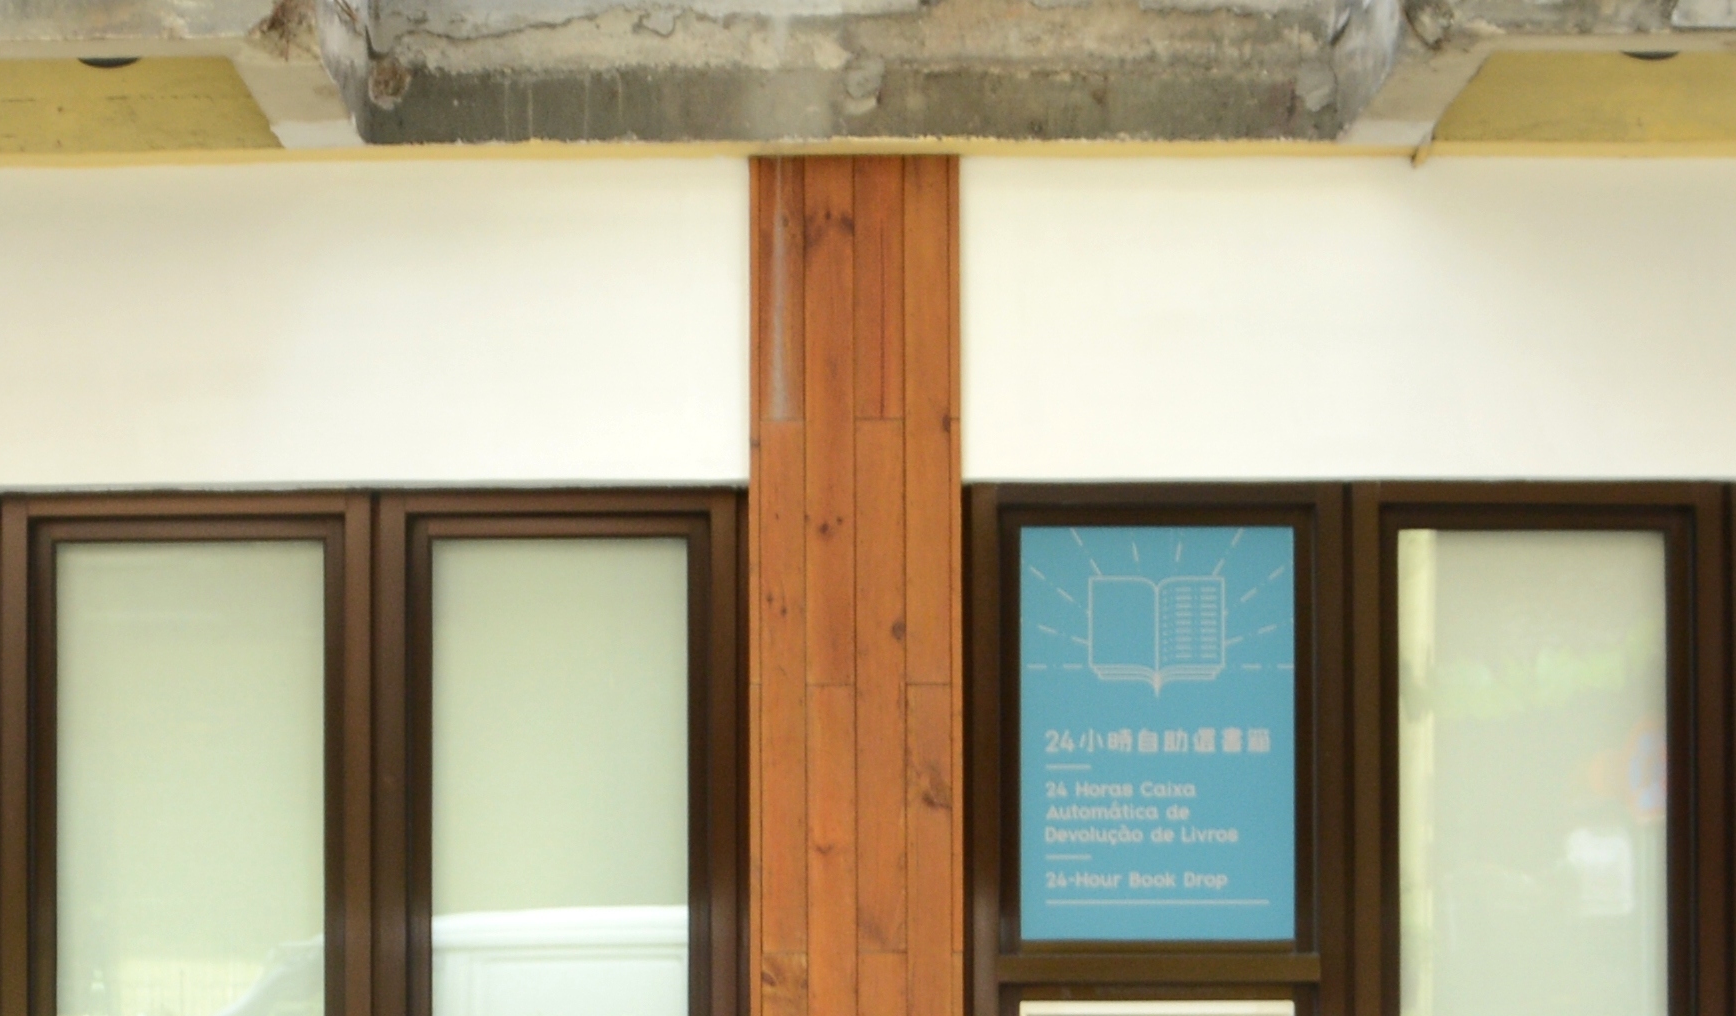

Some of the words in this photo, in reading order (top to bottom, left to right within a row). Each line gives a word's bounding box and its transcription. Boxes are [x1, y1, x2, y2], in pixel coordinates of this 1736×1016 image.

[1045, 781, 1068, 798] 24
[1076, 781, 1133, 798] Horas
[1141, 781, 1196, 798] Caixa
[1046, 802, 1159, 820] Automática
[1166, 804, 1190, 820] de
[1045, 824, 1144, 845] Devolução
[1150, 826, 1174, 843] de
[1181, 826, 1239, 843] Livros
[1046, 871, 1122, 888] 24-Hour
[1129, 871, 1176, 888] Book
[1184, 871, 1228, 889] Drop
